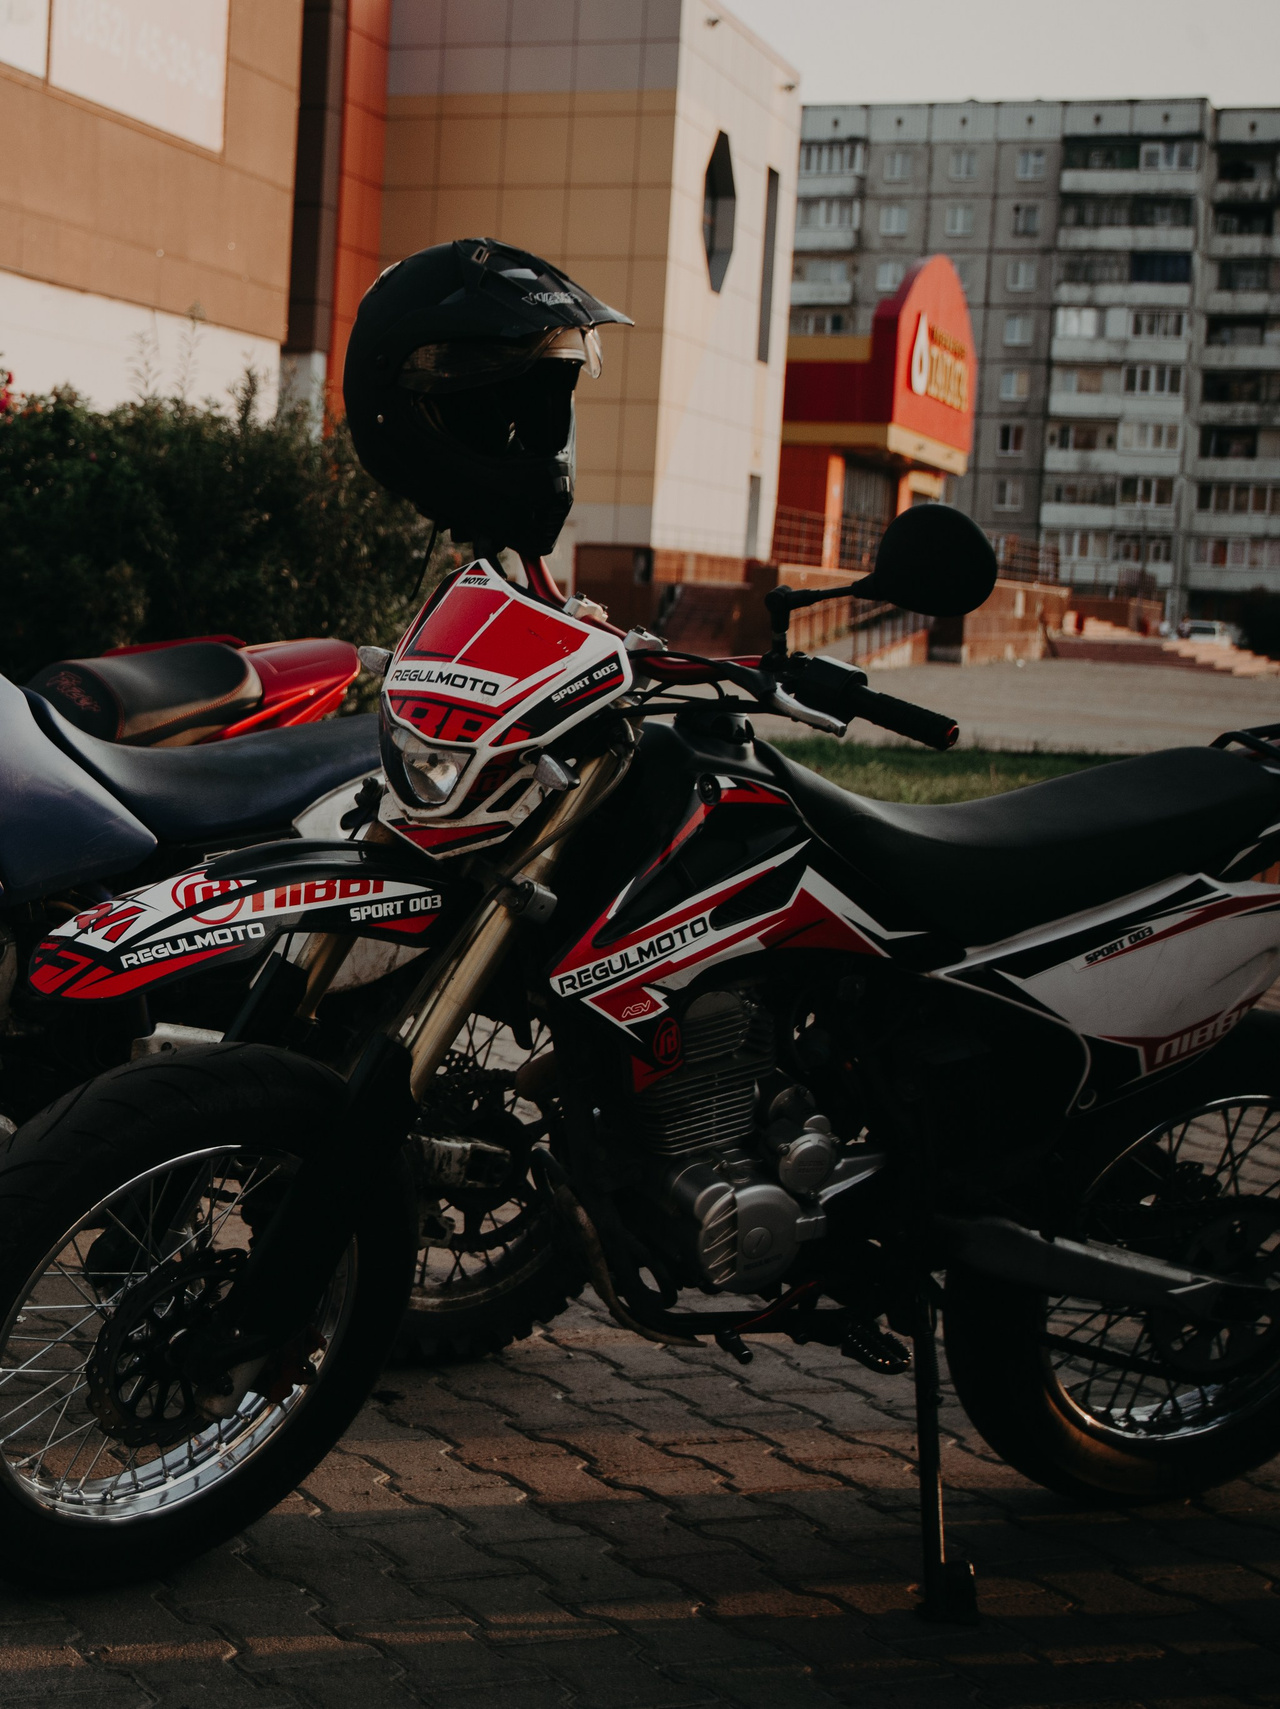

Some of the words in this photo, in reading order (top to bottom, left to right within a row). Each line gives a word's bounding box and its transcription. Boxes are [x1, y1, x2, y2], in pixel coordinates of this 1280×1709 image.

[460, 576, 490, 587] MOTUL
[390, 668, 500, 697] REGULMOTO
[550, 675, 591, 703] SPORT
[592, 661, 619, 682] 003
[349, 900, 405, 922] SPORT
[408, 894, 442, 913] 003
[120, 922, 266, 969] REGULMOTO
[557, 916, 709, 995] REGULMOTO
[1084, 938, 1125, 965] SPORT
[1128, 926, 1155, 945] 003
